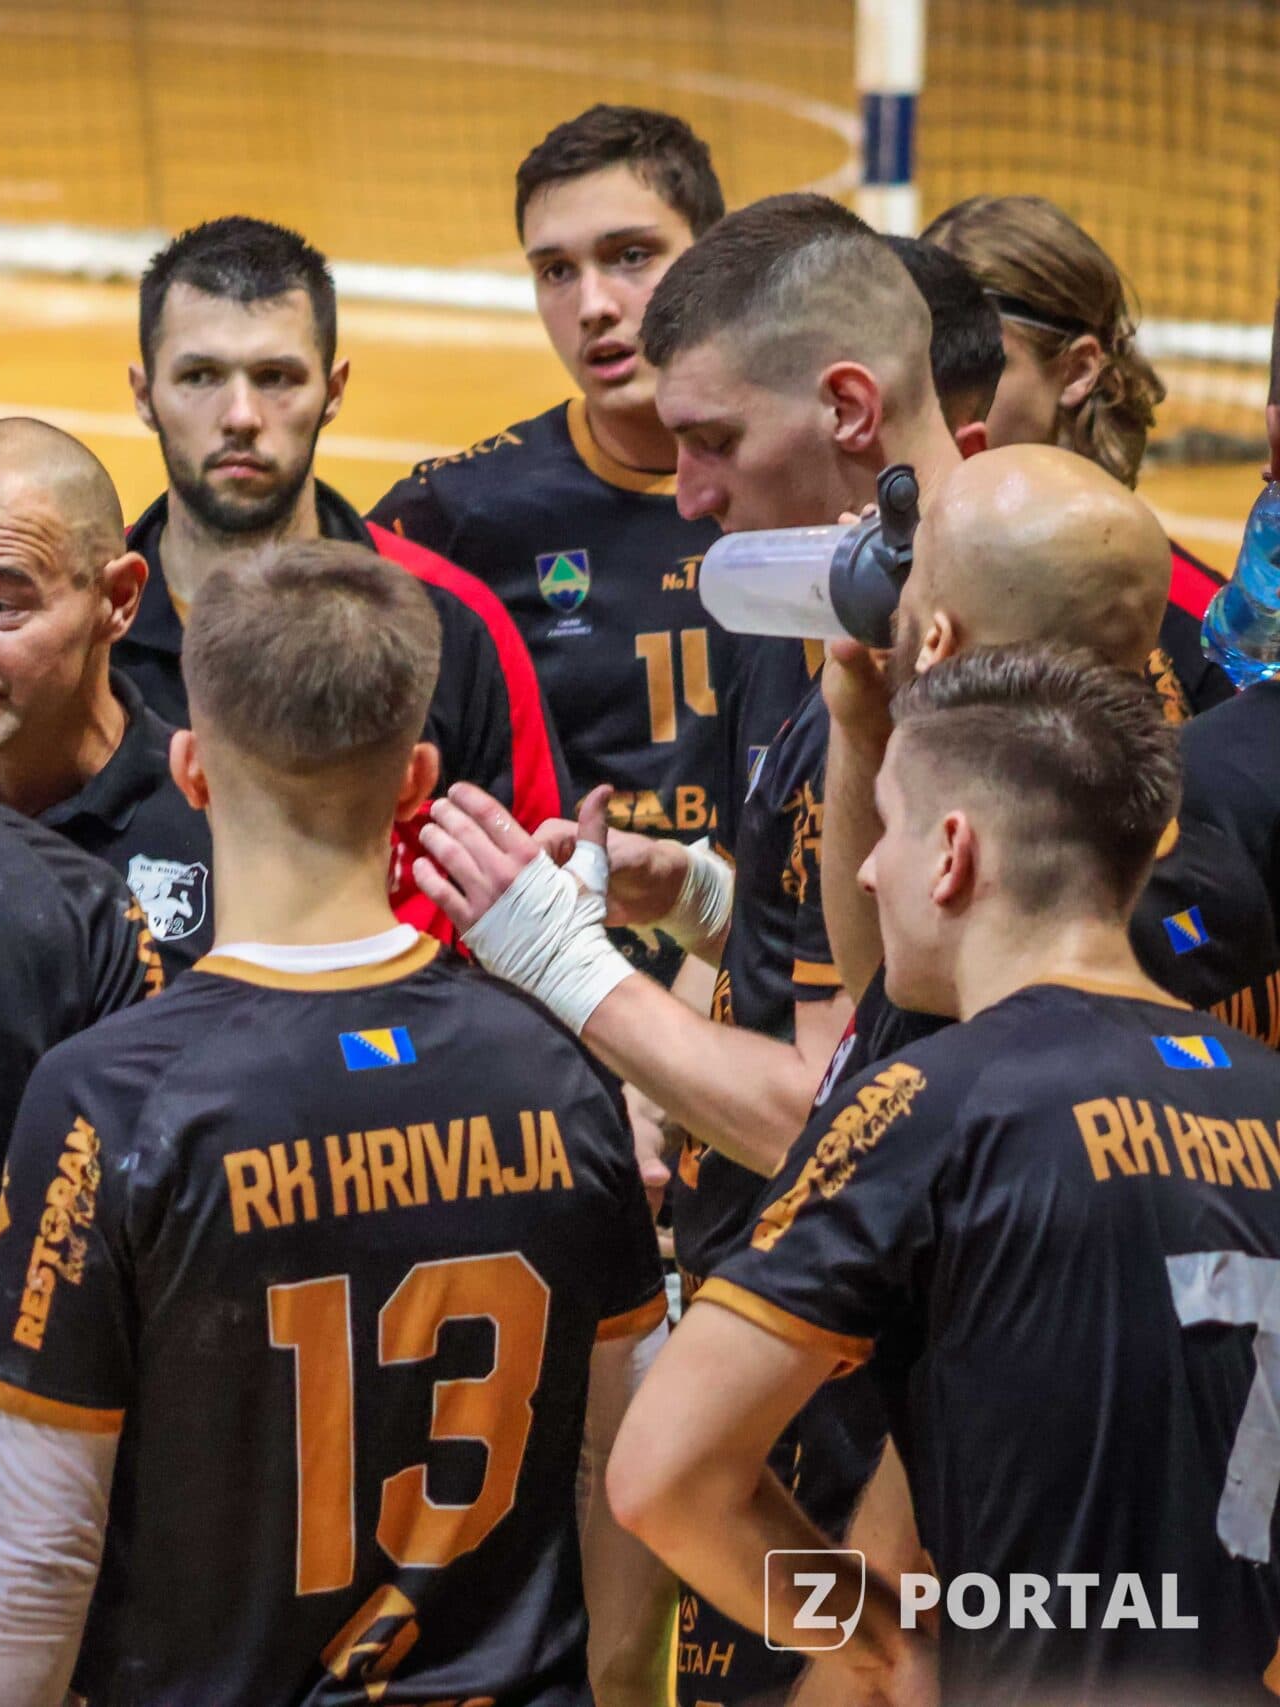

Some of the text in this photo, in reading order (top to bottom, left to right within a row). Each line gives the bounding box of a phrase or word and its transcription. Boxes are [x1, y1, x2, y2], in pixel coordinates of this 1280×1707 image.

[224, 1110, 574, 1234] RK KRIVAJA
[1073, 1096, 1171, 1182] RK
[267, 1251, 551, 1596] 13
